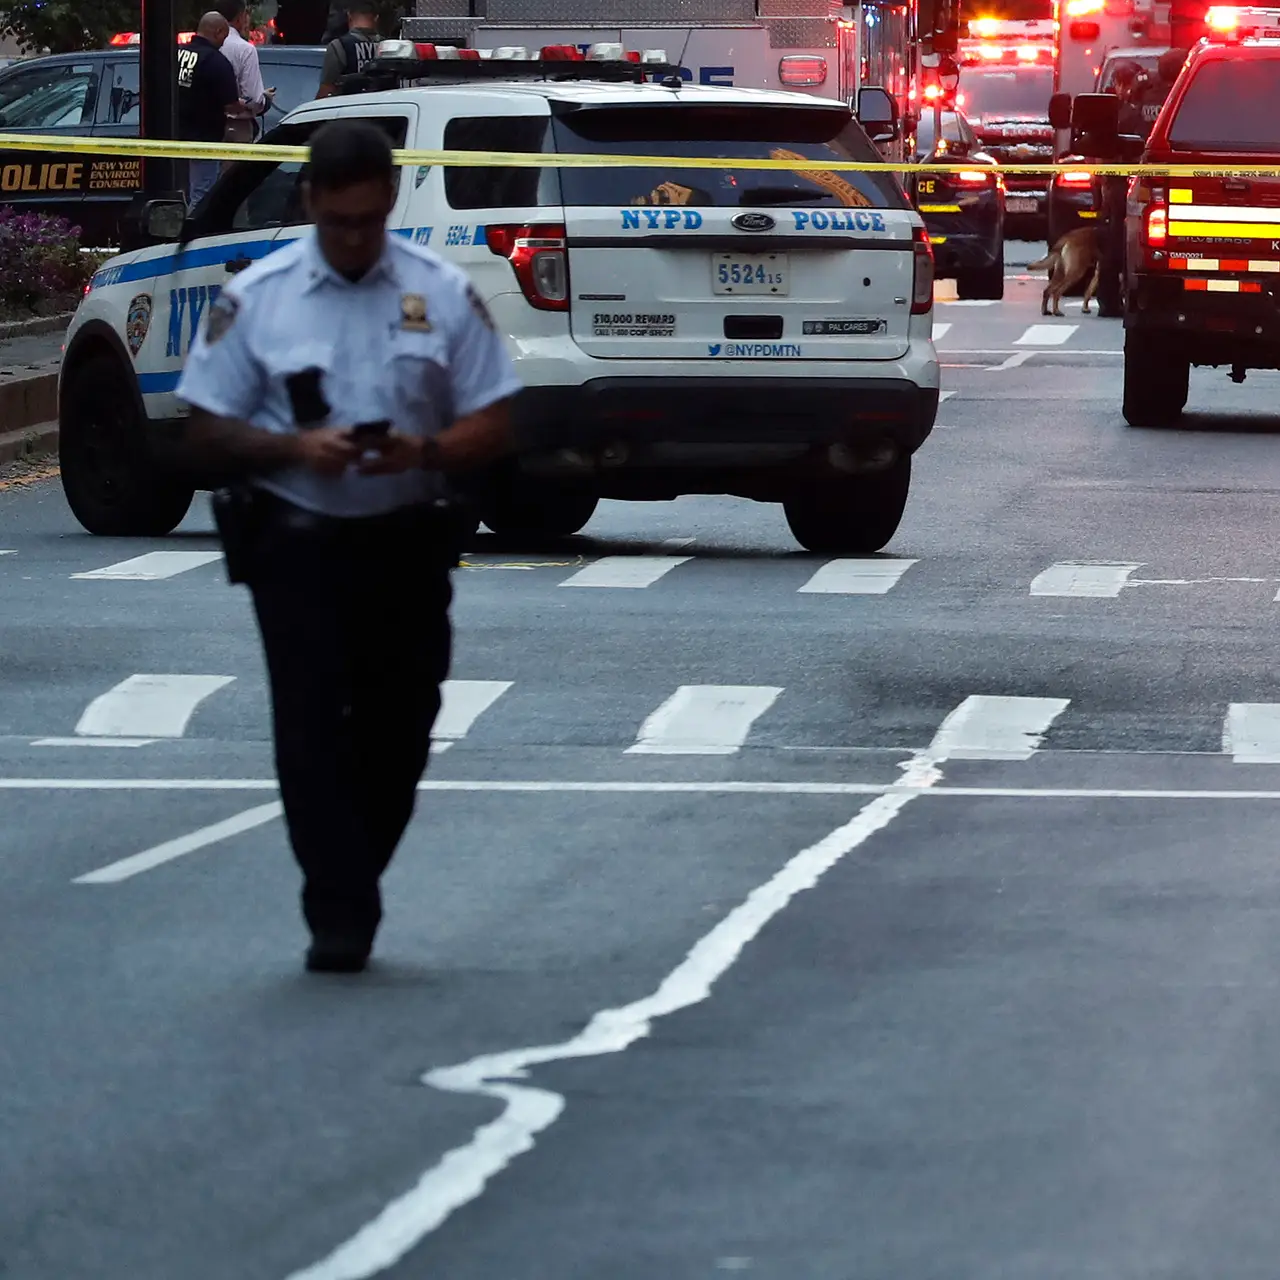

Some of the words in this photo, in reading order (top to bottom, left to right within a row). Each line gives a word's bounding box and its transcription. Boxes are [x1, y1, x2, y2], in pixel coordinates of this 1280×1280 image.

[178, 49, 198, 69] YPD
[178, 68, 194, 82] ICE
[1, 163, 84, 191] OLICE
[91, 161, 117, 170] NEW
[118, 161, 140, 170] YOR
[90, 170, 140, 179] ENVIRON
[89, 179, 141, 189] CONSERV
[620, 210, 703, 230] NYPD
[791, 211, 885, 232] POLICE
[742, 214, 767, 227] Ford
[1177, 236, 1252, 245] SILVERADO
[718, 263, 765, 284] 5524
[768, 274, 782, 284] 15
[166, 284, 222, 358] NY
[594, 313, 632, 325] $10,000
[634, 314, 676, 324] REWARD
[594, 328, 610, 336] CALL
[828, 323, 842, 331] PAL
[843, 323, 868, 331] CARES
[724, 344, 801, 357] @NYPDMTN
